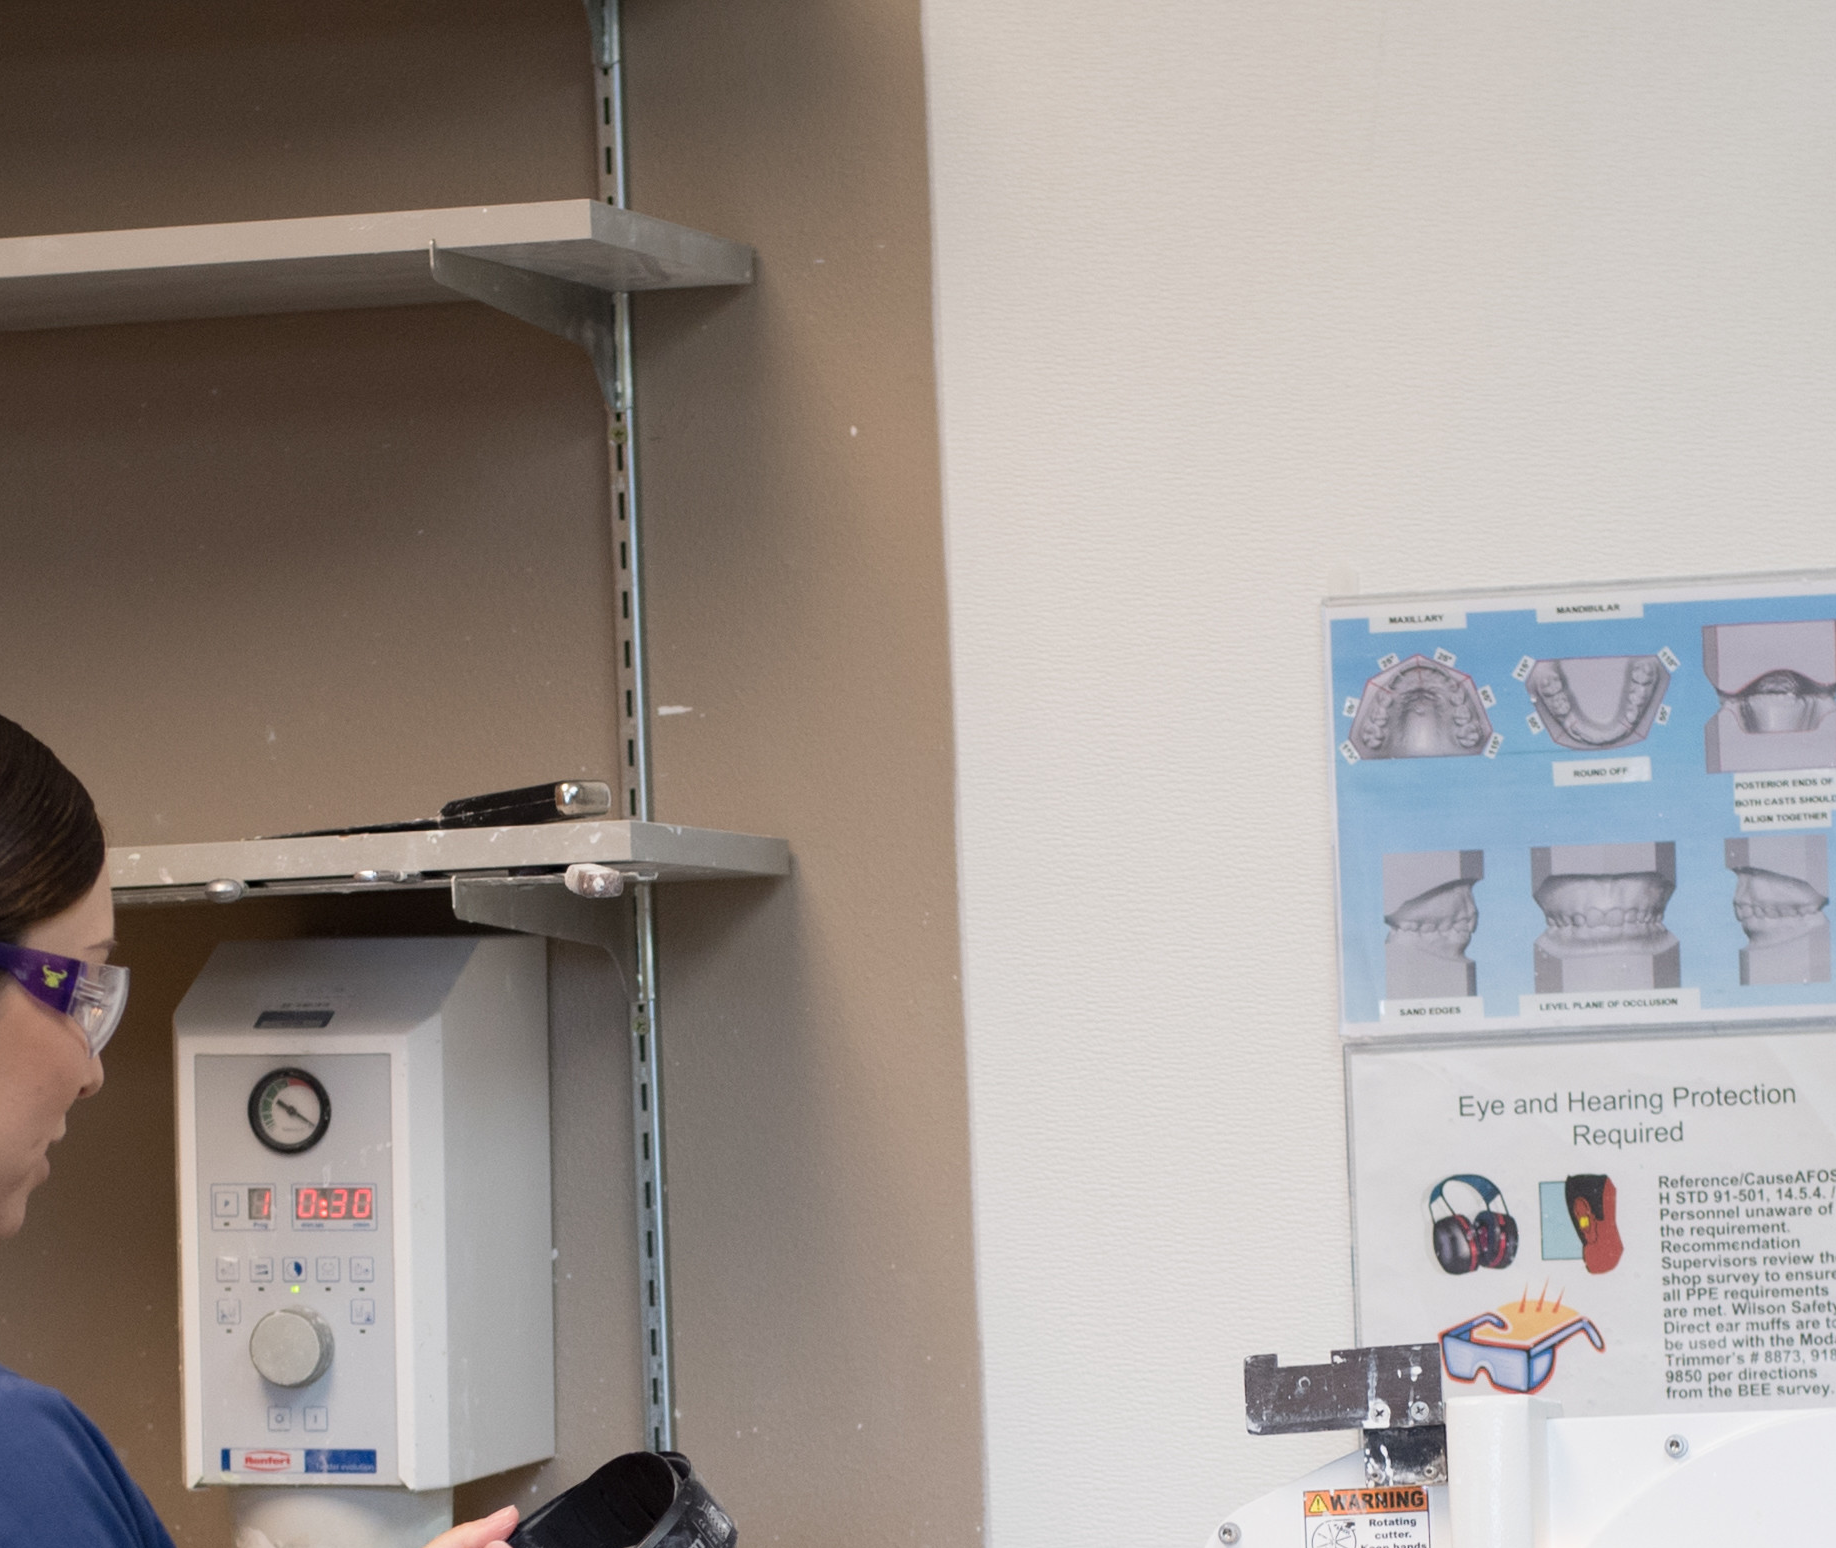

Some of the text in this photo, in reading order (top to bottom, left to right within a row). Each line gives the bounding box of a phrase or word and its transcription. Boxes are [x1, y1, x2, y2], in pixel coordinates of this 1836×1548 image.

[1556, 604, 1620, 614] MANDIBULAR
[1389, 615, 1444, 624] MAXILLARY
[1574, 769, 1606, 777] ROUND
[1736, 780, 1789, 790] POSTERIOR
[1735, 799, 1761, 807] BOTH
[1765, 797, 1796, 805] CASTS
[1744, 812, 1828, 824] ALIGN TOGETHER
[1399, 1006, 1461, 1016] SAND EDGES
[1539, 998, 1678, 1011] LEVEL PLANE OF OCCLUSION
[1459, 1084, 1796, 1121] Eye and Hearing Protection
[1573, 1121, 1684, 1149] Required
[297, 1188, 372, 1218] 0:30
[1659, 1193, 1670, 1204] H
[1676, 1191, 1708, 1204] STD
[1714, 1189, 1770, 1203] 91-501,
[1660, 1203, 1833, 1221] Personnel unaware of
[1660, 1222, 1790, 1238] the requirement.
[1661, 1238, 1800, 1253] Recommendation
[1662, 1255, 1757, 1271] Supervisors
[1764, 1253, 1813, 1265] review
[1662, 1273, 1701, 1286] shop
[1707, 1273, 1759, 1286] survey
[1765, 1270, 1779, 1281] to
[1663, 1285, 1829, 1301] all PPE requirements
[1664, 1307, 1687, 1318] are
[1693, 1305, 1726, 1316] met.
[1732, 1302, 1786, 1315] Wilson
[1665, 1321, 1710, 1333] Direct
[1716, 1321, 1740, 1332] ear
[1746, 1318, 1790, 1331] muffs
[1796, 1318, 1820, 1329] are
[1665, 1338, 1683, 1350] be
[1689, 1337, 1726, 1349] used
[1732, 1335, 1764, 1348] with
[1770, 1334, 1794, 1346] the
[1666, 1352, 1745, 1367] Trimmer's
[1750, 1352, 1758, 1364] #
[1764, 1351, 1806, 1364] 8873,
[1666, 1367, 1817, 1384] 9850 per directions
[1666, 1384, 1834, 1398] from the BEE survey.
[1330, 1491, 1423, 1511] WARNING
[1369, 1518, 1416, 1527] Rotating
[1375, 1531, 1411, 1539] cutter.
